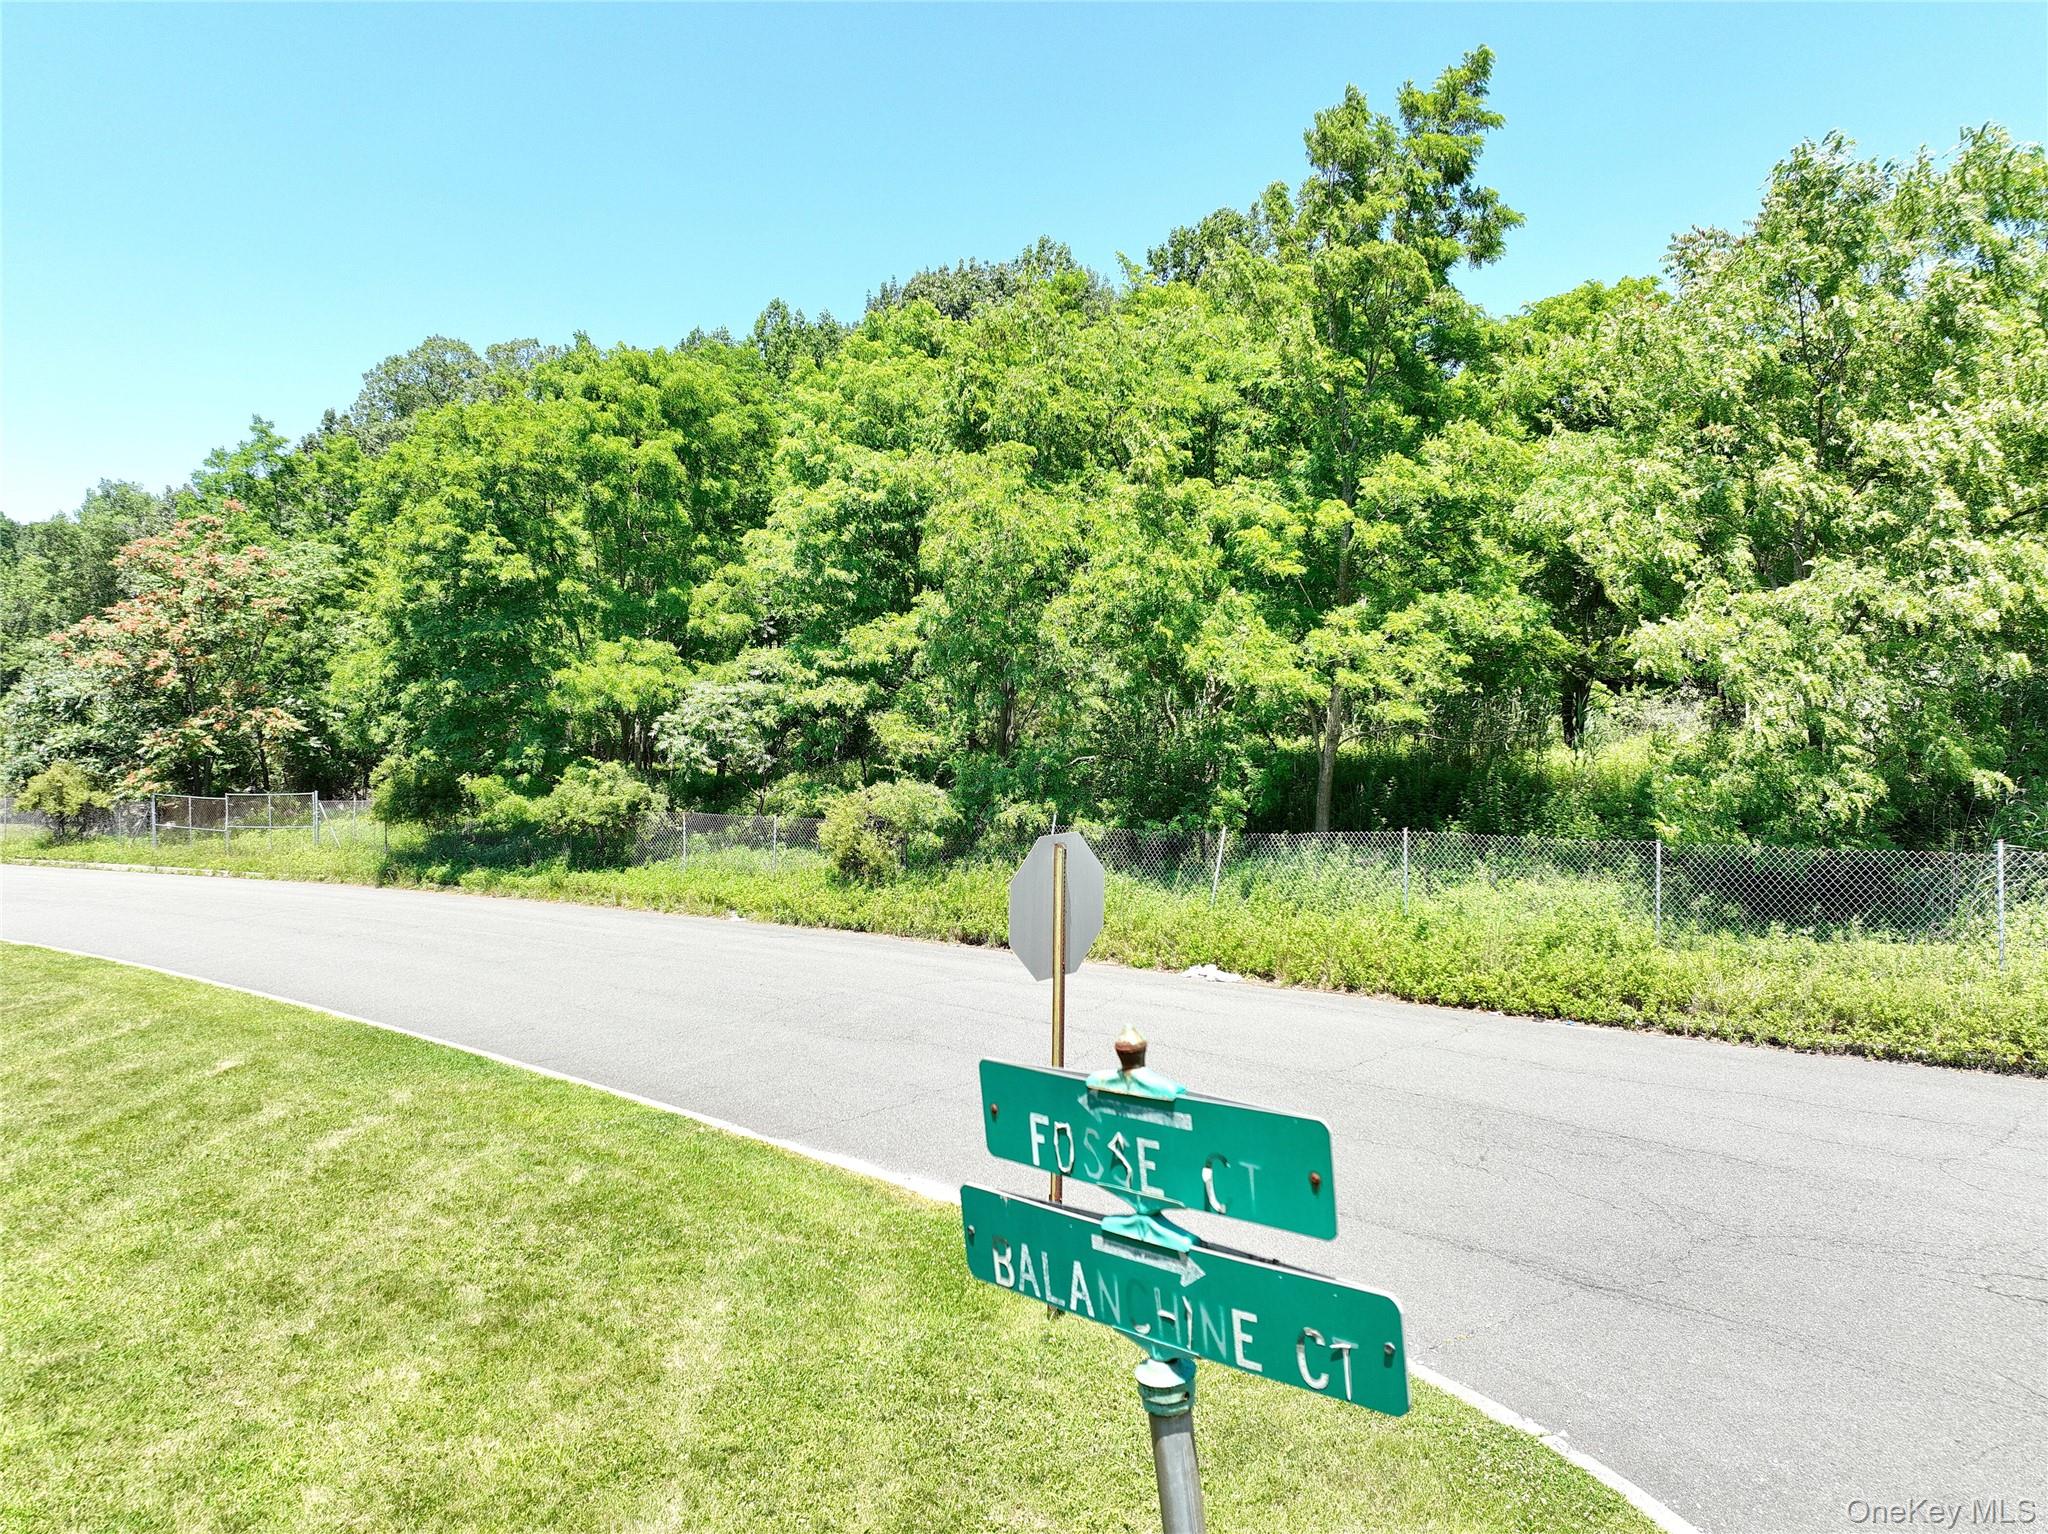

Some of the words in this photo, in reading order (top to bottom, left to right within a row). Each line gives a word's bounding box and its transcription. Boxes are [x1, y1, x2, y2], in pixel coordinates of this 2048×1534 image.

[1028, 1111, 1166, 1199] FOSSE
[1201, 1152, 1261, 1214] CT
[991, 1235, 1264, 1373] BALANCHINE
[1296, 1326, 1359, 1401] CT
